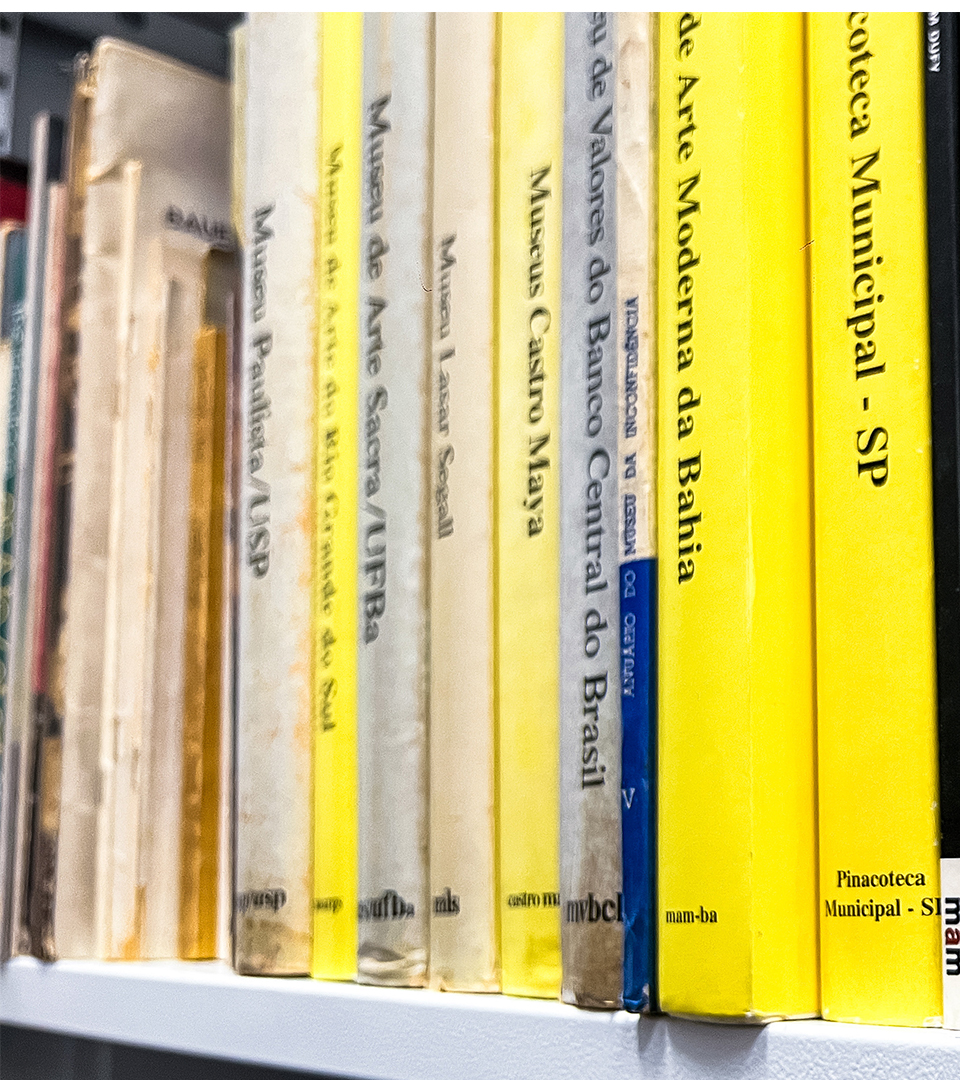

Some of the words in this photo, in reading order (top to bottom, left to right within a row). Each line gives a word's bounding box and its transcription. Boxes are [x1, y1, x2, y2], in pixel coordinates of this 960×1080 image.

[587, 56, 613, 102] de
[677, 13, 702, 61] de
[928, 29, 941, 73] DUFY
[367, 93, 392, 224] Museu
[676, 72, 700, 164] Arte
[587, 104, 613, 247] Valores
[253, 200, 276, 324] Museu
[366, 235, 390, 281] de
[528, 159, 553, 300] Museus
[676, 168, 702, 372] Moderna
[846, 145, 886, 381] Municipal
[438, 233, 457, 340] Museu
[586, 256, 613, 306] do
[366, 296, 389, 377] Arte
[527, 304, 553, 423] Castro
[586, 312, 612, 439] Banco
[437, 346, 456, 437] Lasar
[677, 386, 702, 440] da
[436, 443, 455, 541] Segall
[527, 430, 552, 539] Maya
[623, 451, 638, 479] DA
[856, 426, 890, 488] SP
[584, 450, 612, 596] Central
[623, 494, 638, 557] MUSEU
[677, 451, 703, 585] Bahia
[583, 609, 609, 659] do
[582, 671, 609, 790] Brasil
[432, 886, 461, 915] mls
[665, 905, 718, 924] mam-ba
[825, 897, 901, 922] Municipal
[836, 869, 926, 889] Pinacoteca
